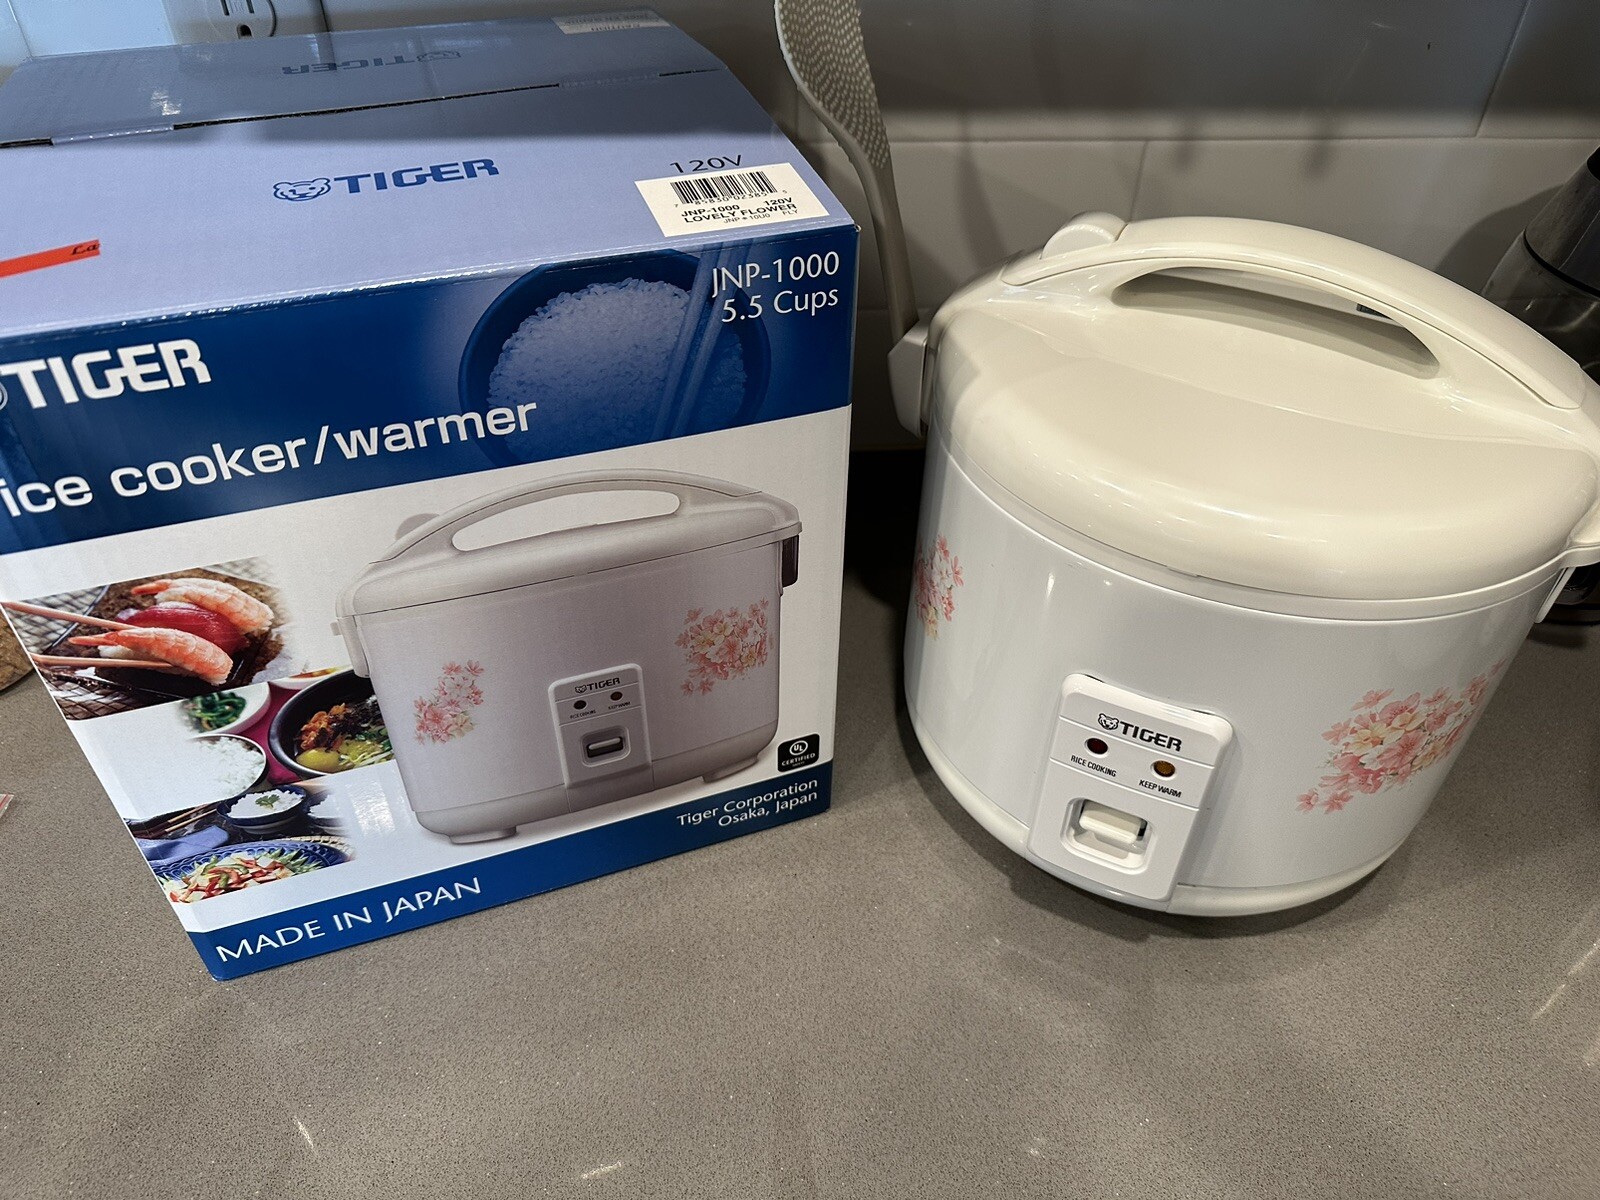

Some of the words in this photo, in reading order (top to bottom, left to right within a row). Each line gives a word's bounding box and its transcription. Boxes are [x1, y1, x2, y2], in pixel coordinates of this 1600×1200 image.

[281, 55, 415, 76] TIGER
[334, 158, 500, 194] TIGER
[670, 154, 742, 174] 120V
[681, 204, 740, 217] JNP-1000
[764, 197, 793, 206] 120V
[684, 211, 739, 223] LOVELY
[740, 203, 797, 215] FLOWER
[711, 251, 840, 298] JNP-1000
[721, 294, 763, 323] 5.5
[773, 286, 839, 318] Cups
[0, 337, 212, 409] TIGER
[110, 402, 537, 497] cooker/warmer
[587, 677, 620, 691] TIGER
[1120, 721, 1182, 752] TIGER
[781, 753, 816, 766] CERTIFIED
[1070, 755, 1087, 767] RICE
[1087, 761, 1117, 777] COOKING
[676, 808, 719, 825] Tiger
[723, 780, 818, 812] Corporation
[1138, 779, 1158, 791] KEEP
[1158, 785, 1182, 798] WARM
[718, 808, 770, 827] Osaka,
[775, 791, 818, 813] Japan
[215, 919, 326, 962] MADE
[333, 906, 373, 932] IN
[382, 877, 482, 923] JAPAN
